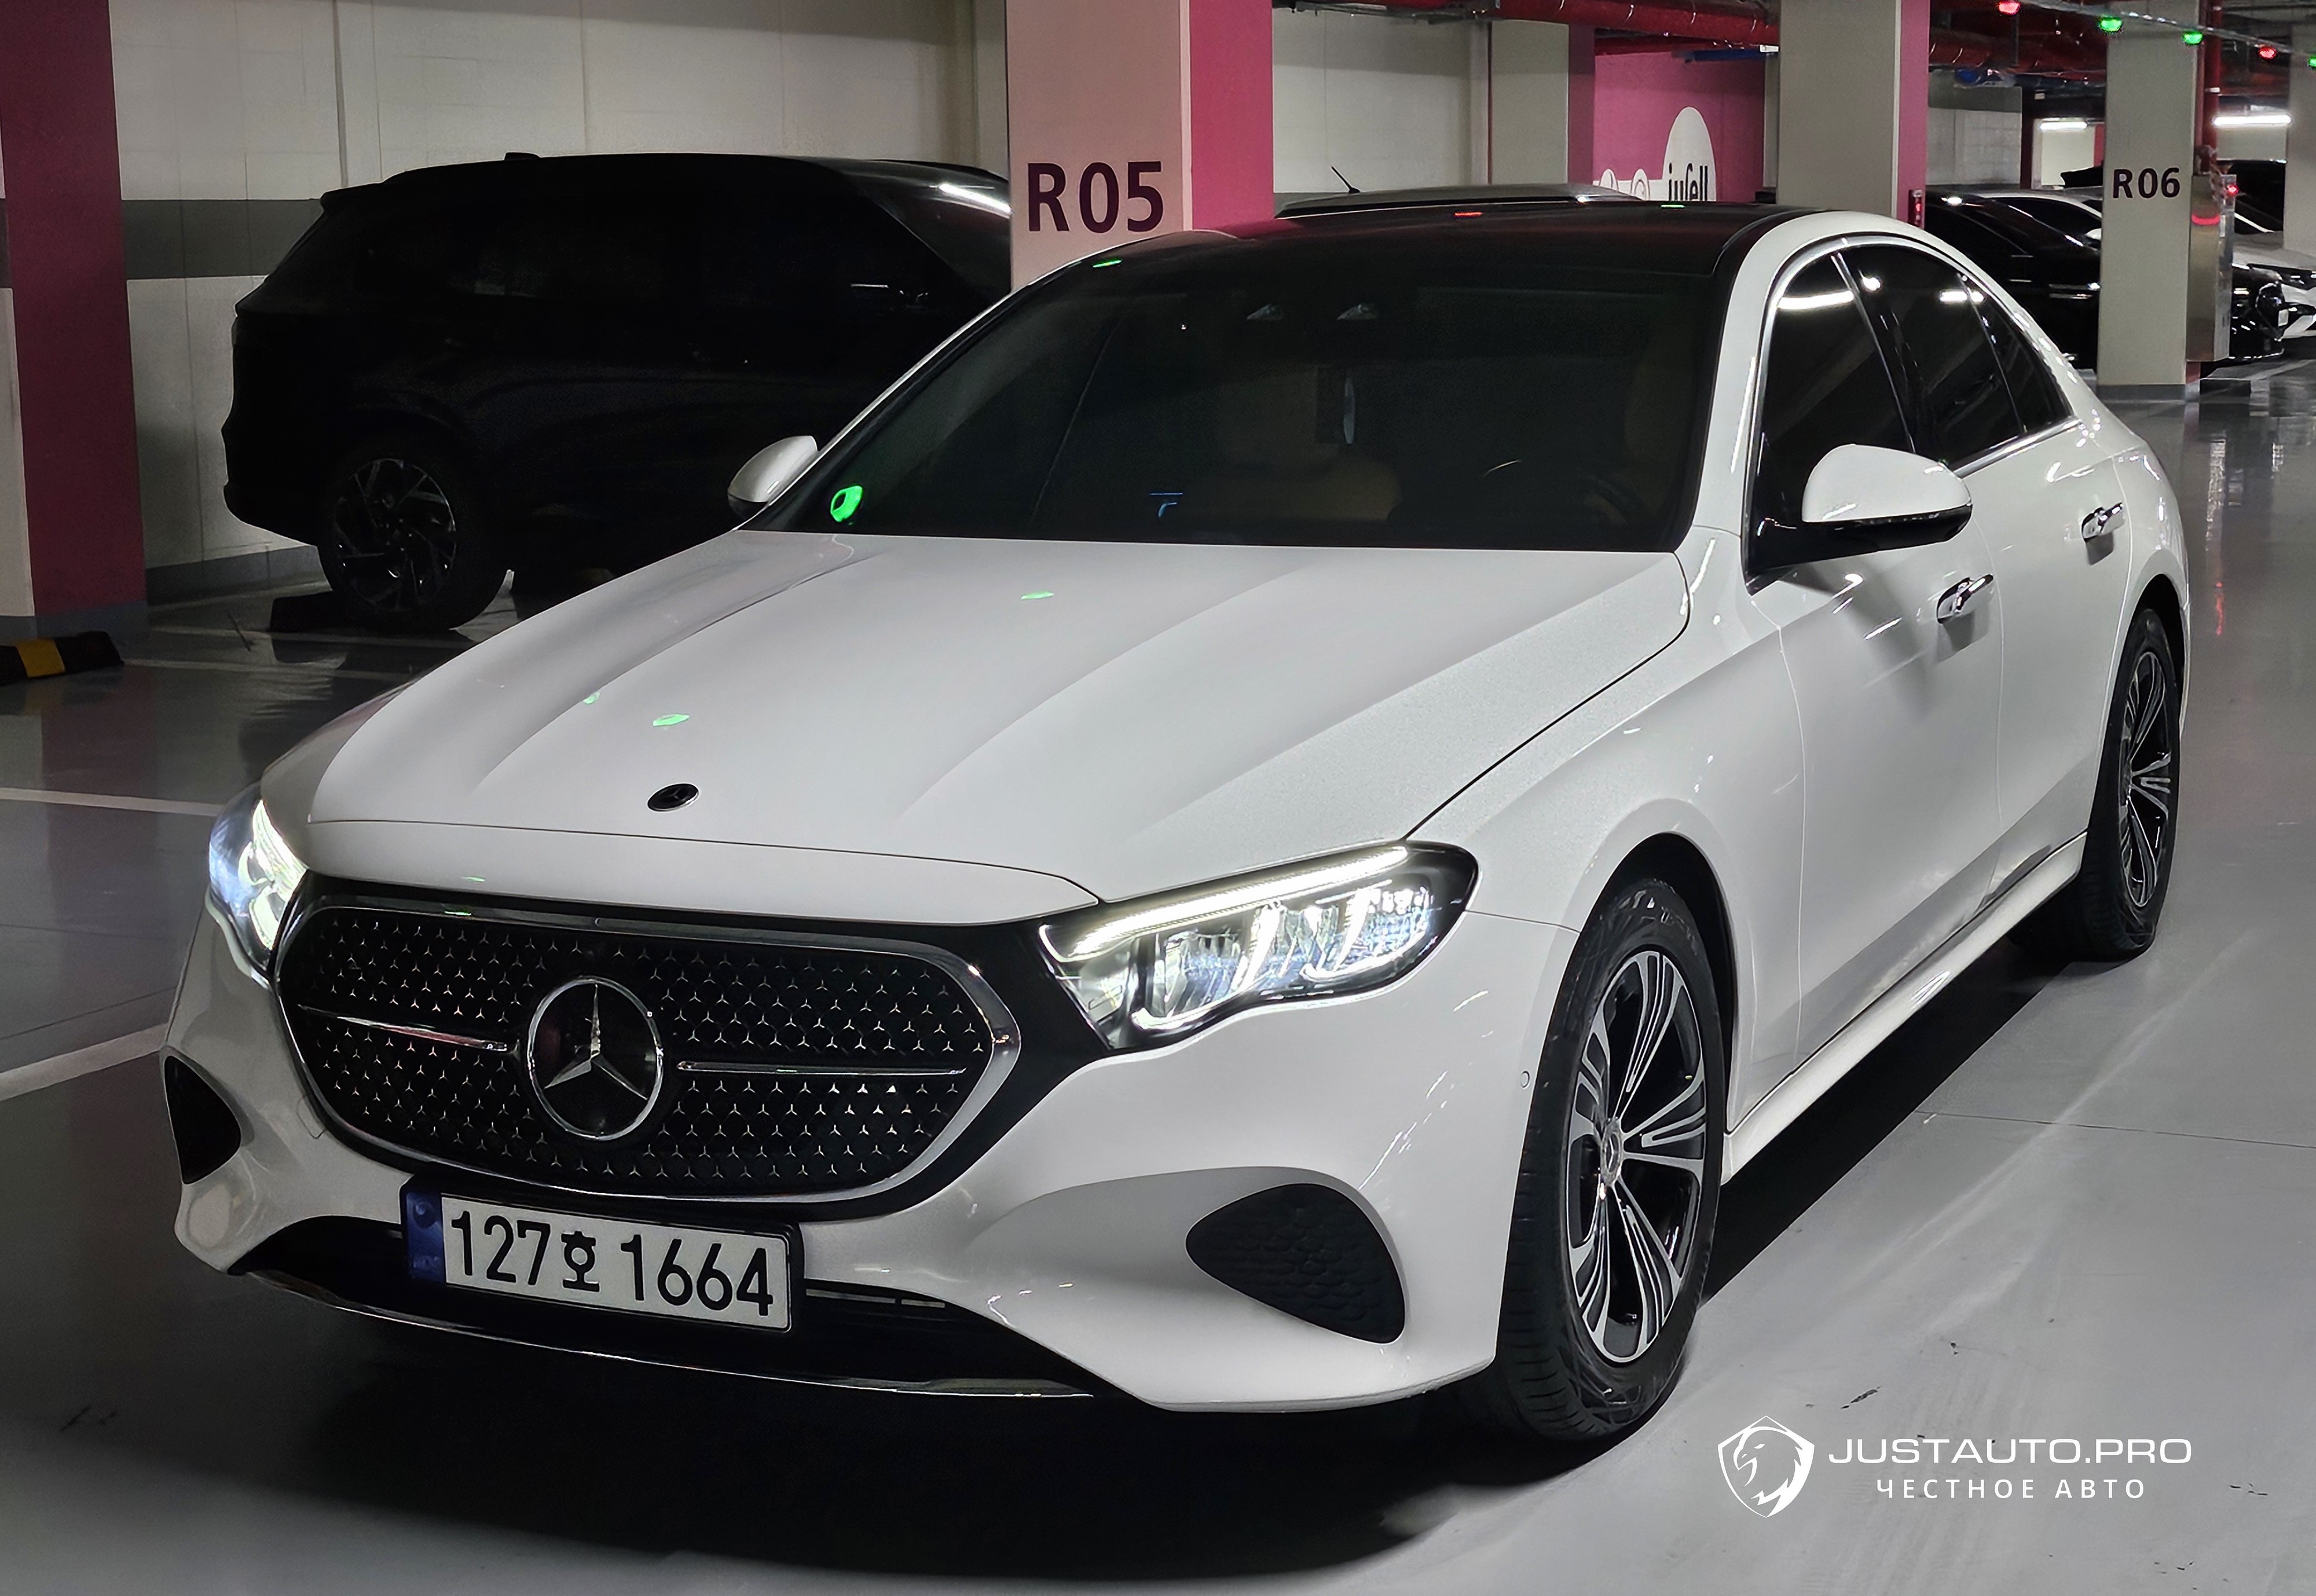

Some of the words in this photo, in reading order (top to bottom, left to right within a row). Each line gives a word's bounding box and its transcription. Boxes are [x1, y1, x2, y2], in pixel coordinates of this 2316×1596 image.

[1027, 160, 1164, 233] R05
[2113, 167, 2181, 199] R06
[451, 1210, 600, 1293] 127호
[620, 1234, 774, 1316] 1664
